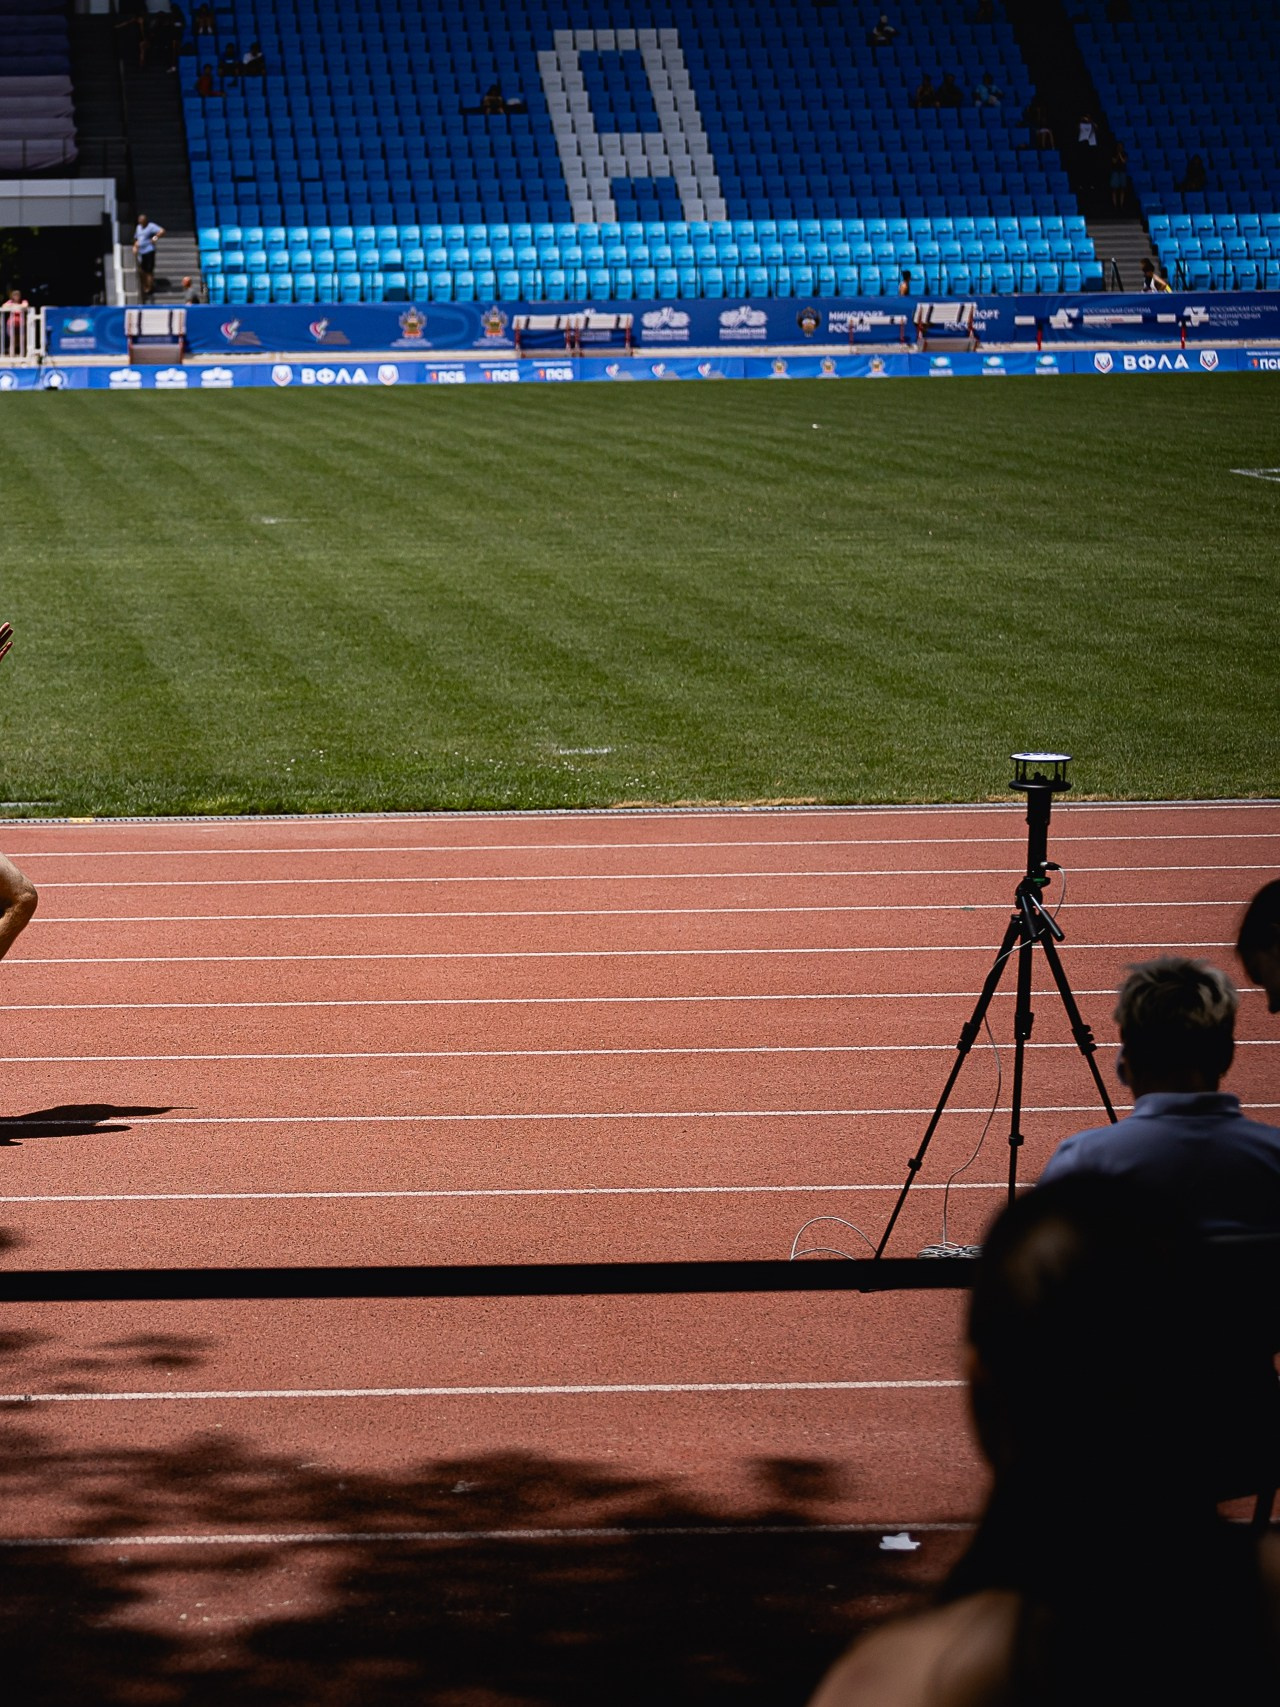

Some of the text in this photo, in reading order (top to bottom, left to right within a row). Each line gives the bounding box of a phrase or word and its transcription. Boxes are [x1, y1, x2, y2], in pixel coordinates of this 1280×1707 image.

[1124, 354, 1190, 371] ВФЛА
[301, 367, 369, 384] ВФЛА
[438, 370, 466, 383] ПСБ
[491, 369, 520, 382] ПСБ
[545, 368, 574, 381] ПСБ
